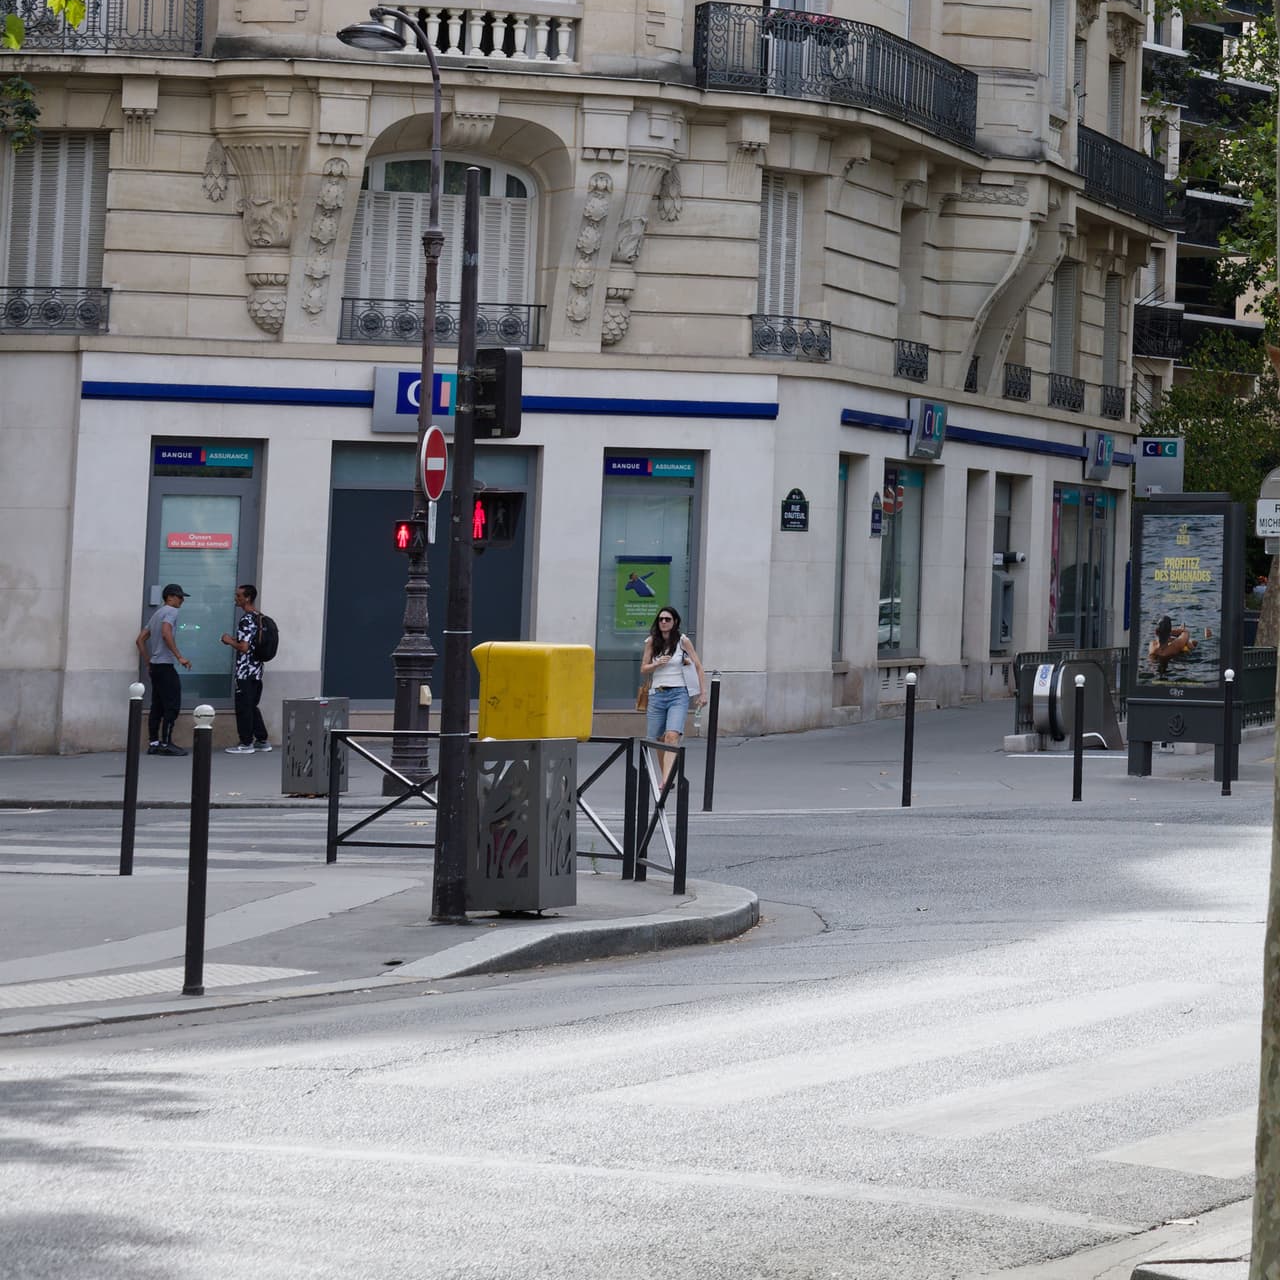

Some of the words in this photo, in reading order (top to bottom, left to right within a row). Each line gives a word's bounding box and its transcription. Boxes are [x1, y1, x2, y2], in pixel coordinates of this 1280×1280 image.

[925, 409, 943, 437] CIC
[161, 451, 193, 460] BANQUE
[209, 452, 249, 461] ASSURANCE
[1145, 443, 1176, 456] CIC
[655, 463, 692, 471] ASSURANCE
[1164, 557, 1201, 570] PROFITEZ
[1154, 569, 1169, 582] DES
[1170, 569, 1212, 583] BAIGNADES
